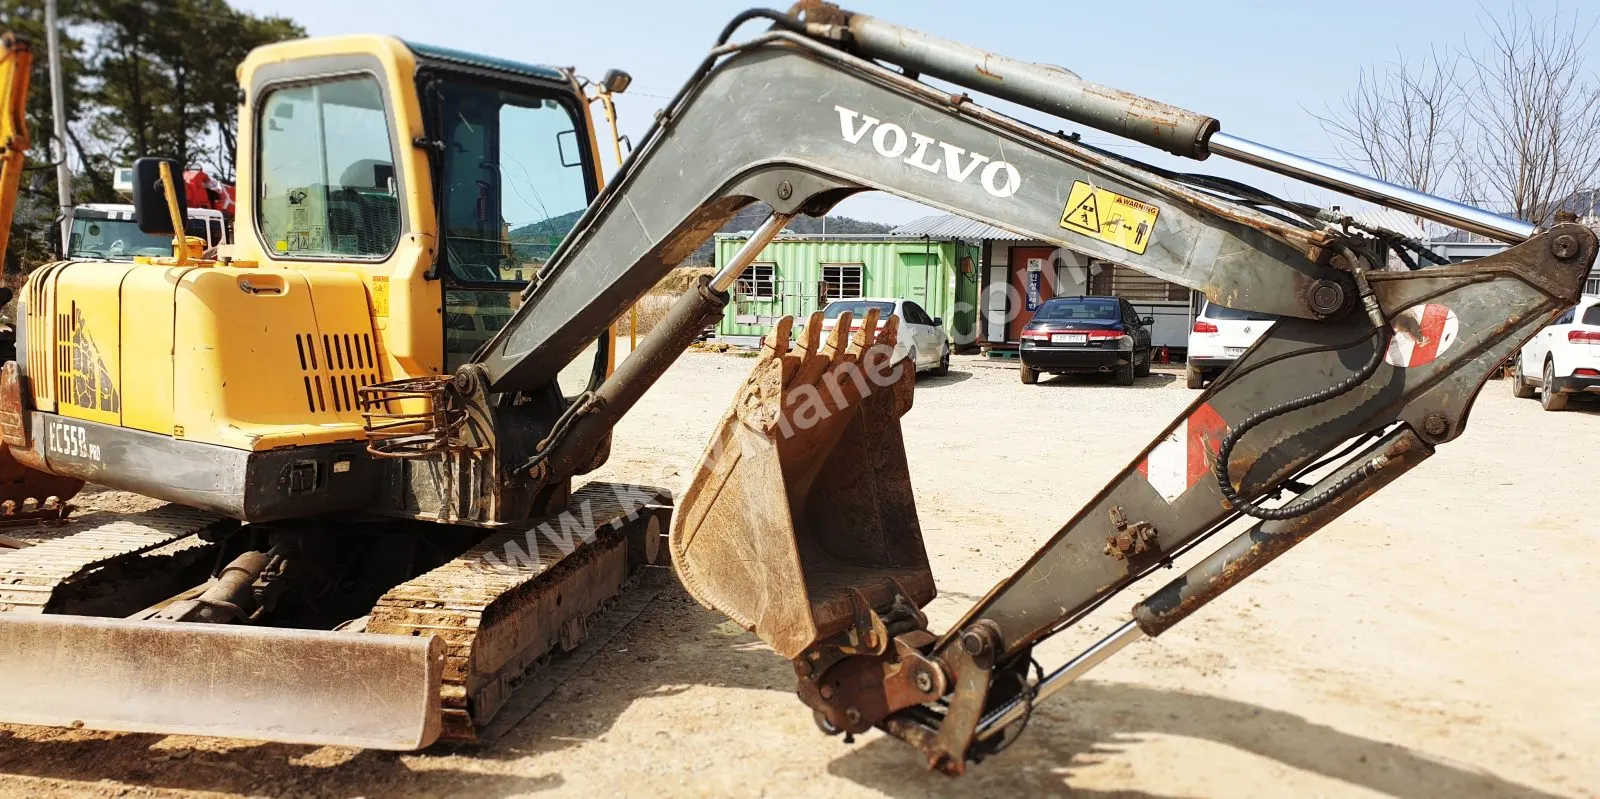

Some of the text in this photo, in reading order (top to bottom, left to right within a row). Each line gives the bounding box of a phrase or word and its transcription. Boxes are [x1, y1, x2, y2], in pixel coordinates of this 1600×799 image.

[834, 105, 1021, 198] VOLVO
[1123, 198, 1157, 214] WARNING
[49, 422, 101, 461] EC55B PRO
